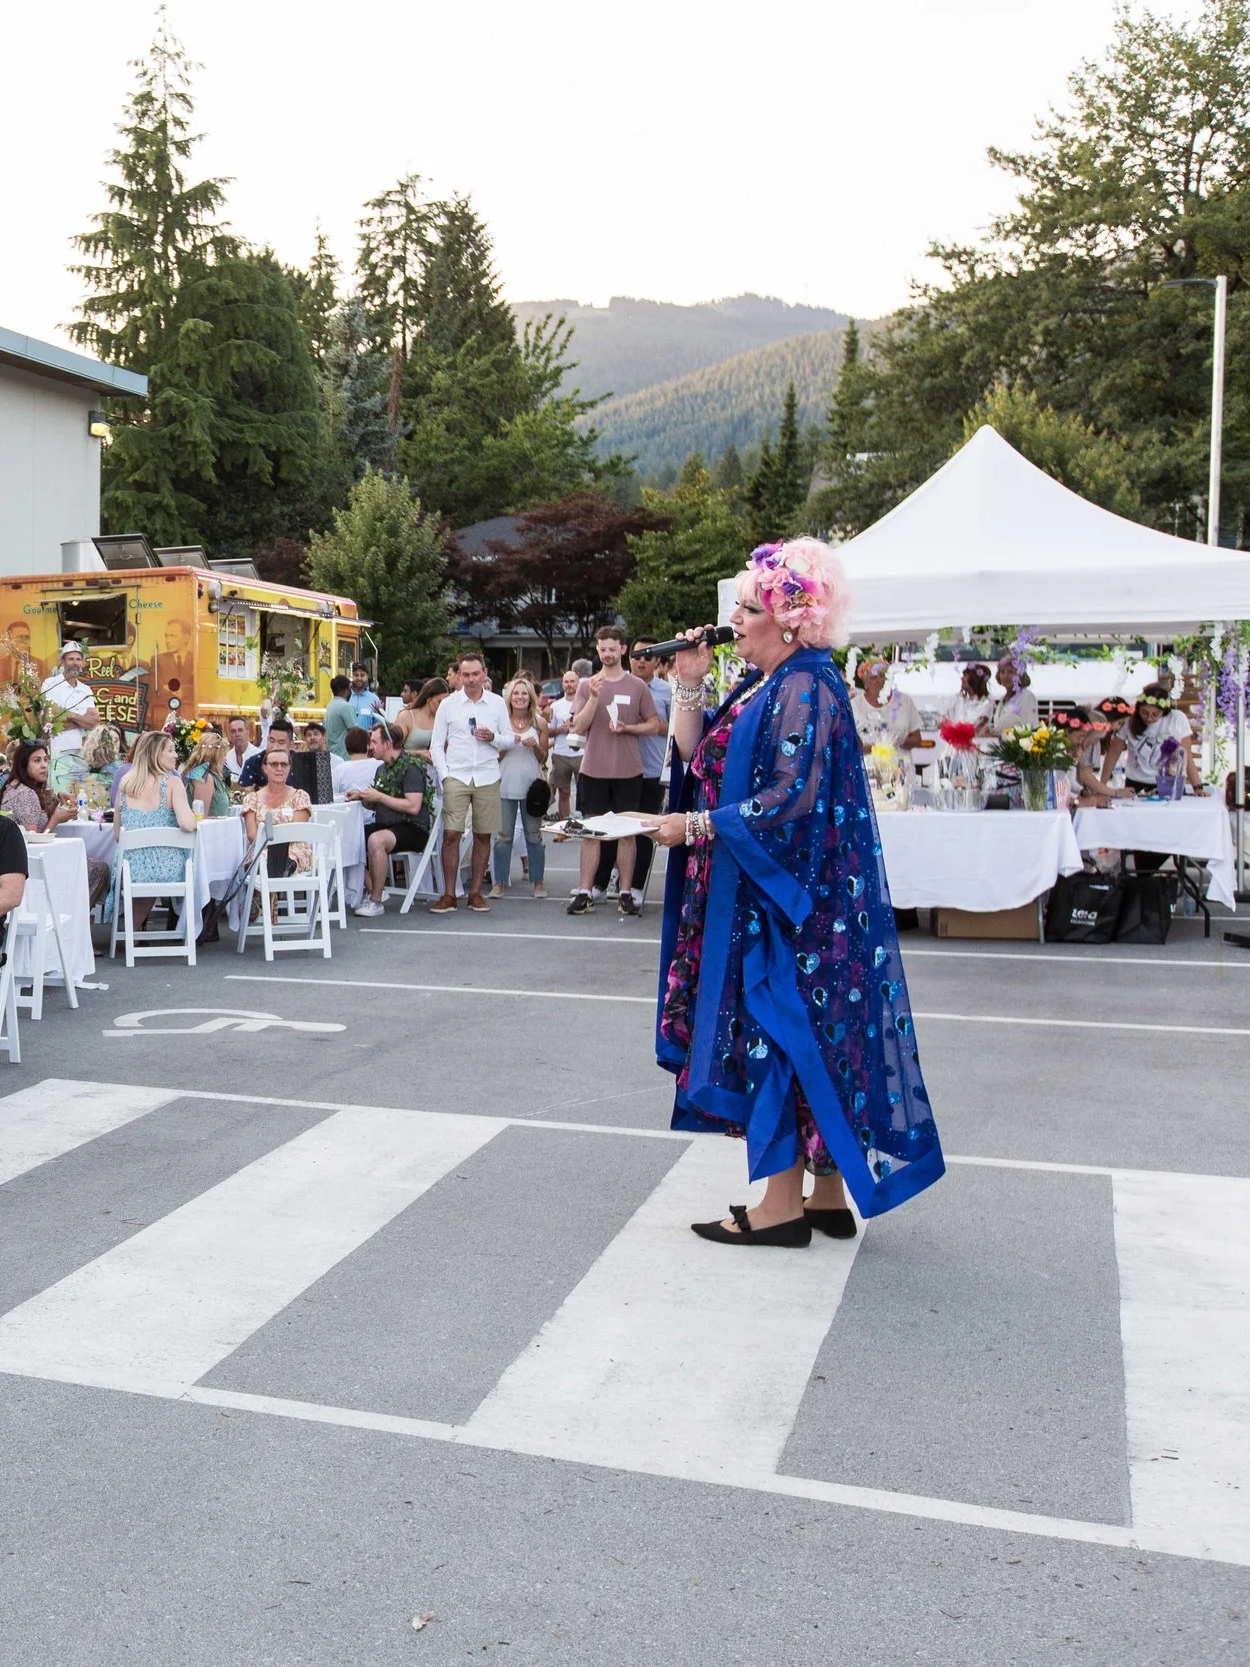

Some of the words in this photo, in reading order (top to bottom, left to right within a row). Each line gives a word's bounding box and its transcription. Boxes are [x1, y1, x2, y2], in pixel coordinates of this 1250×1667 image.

[23, 604, 57, 615] Gourme
[128, 598, 163, 609] Cheese
[86, 656, 115, 679] Reel
[114, 691, 138, 705] and
[96, 704, 138, 723] EESE
